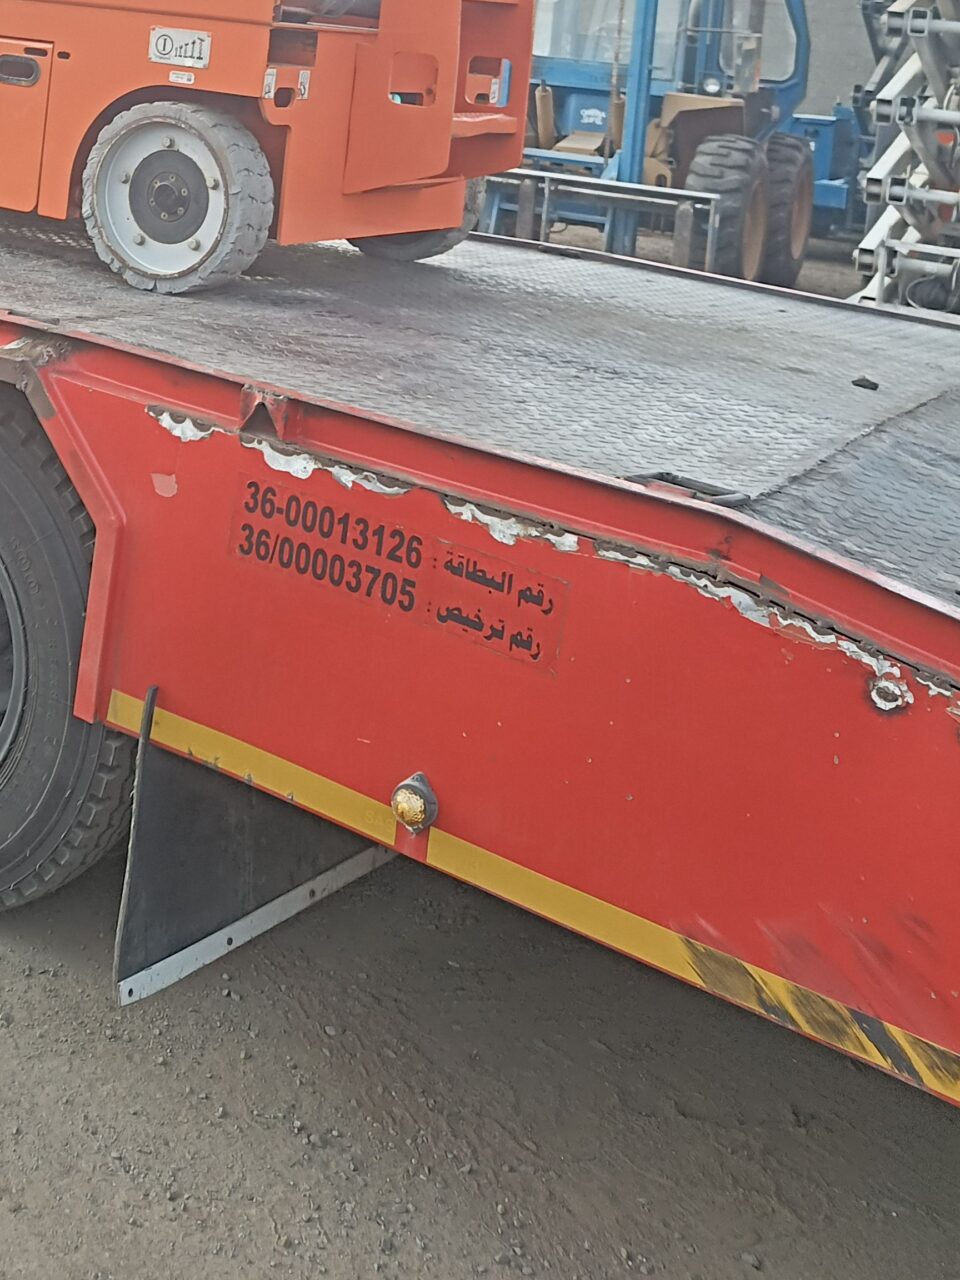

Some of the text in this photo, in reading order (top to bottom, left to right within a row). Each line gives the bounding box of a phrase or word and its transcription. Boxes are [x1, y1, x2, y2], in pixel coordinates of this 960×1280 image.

[244, 481, 423, 569] 36-00013126
[239, 523, 417, 612] 36/00003705
[443, 551, 513, 595] البطاقة
[518, 583, 554, 615] رقم
[436, 603, 505, 641] ترخيص
[509, 627, 541, 660] رقم
